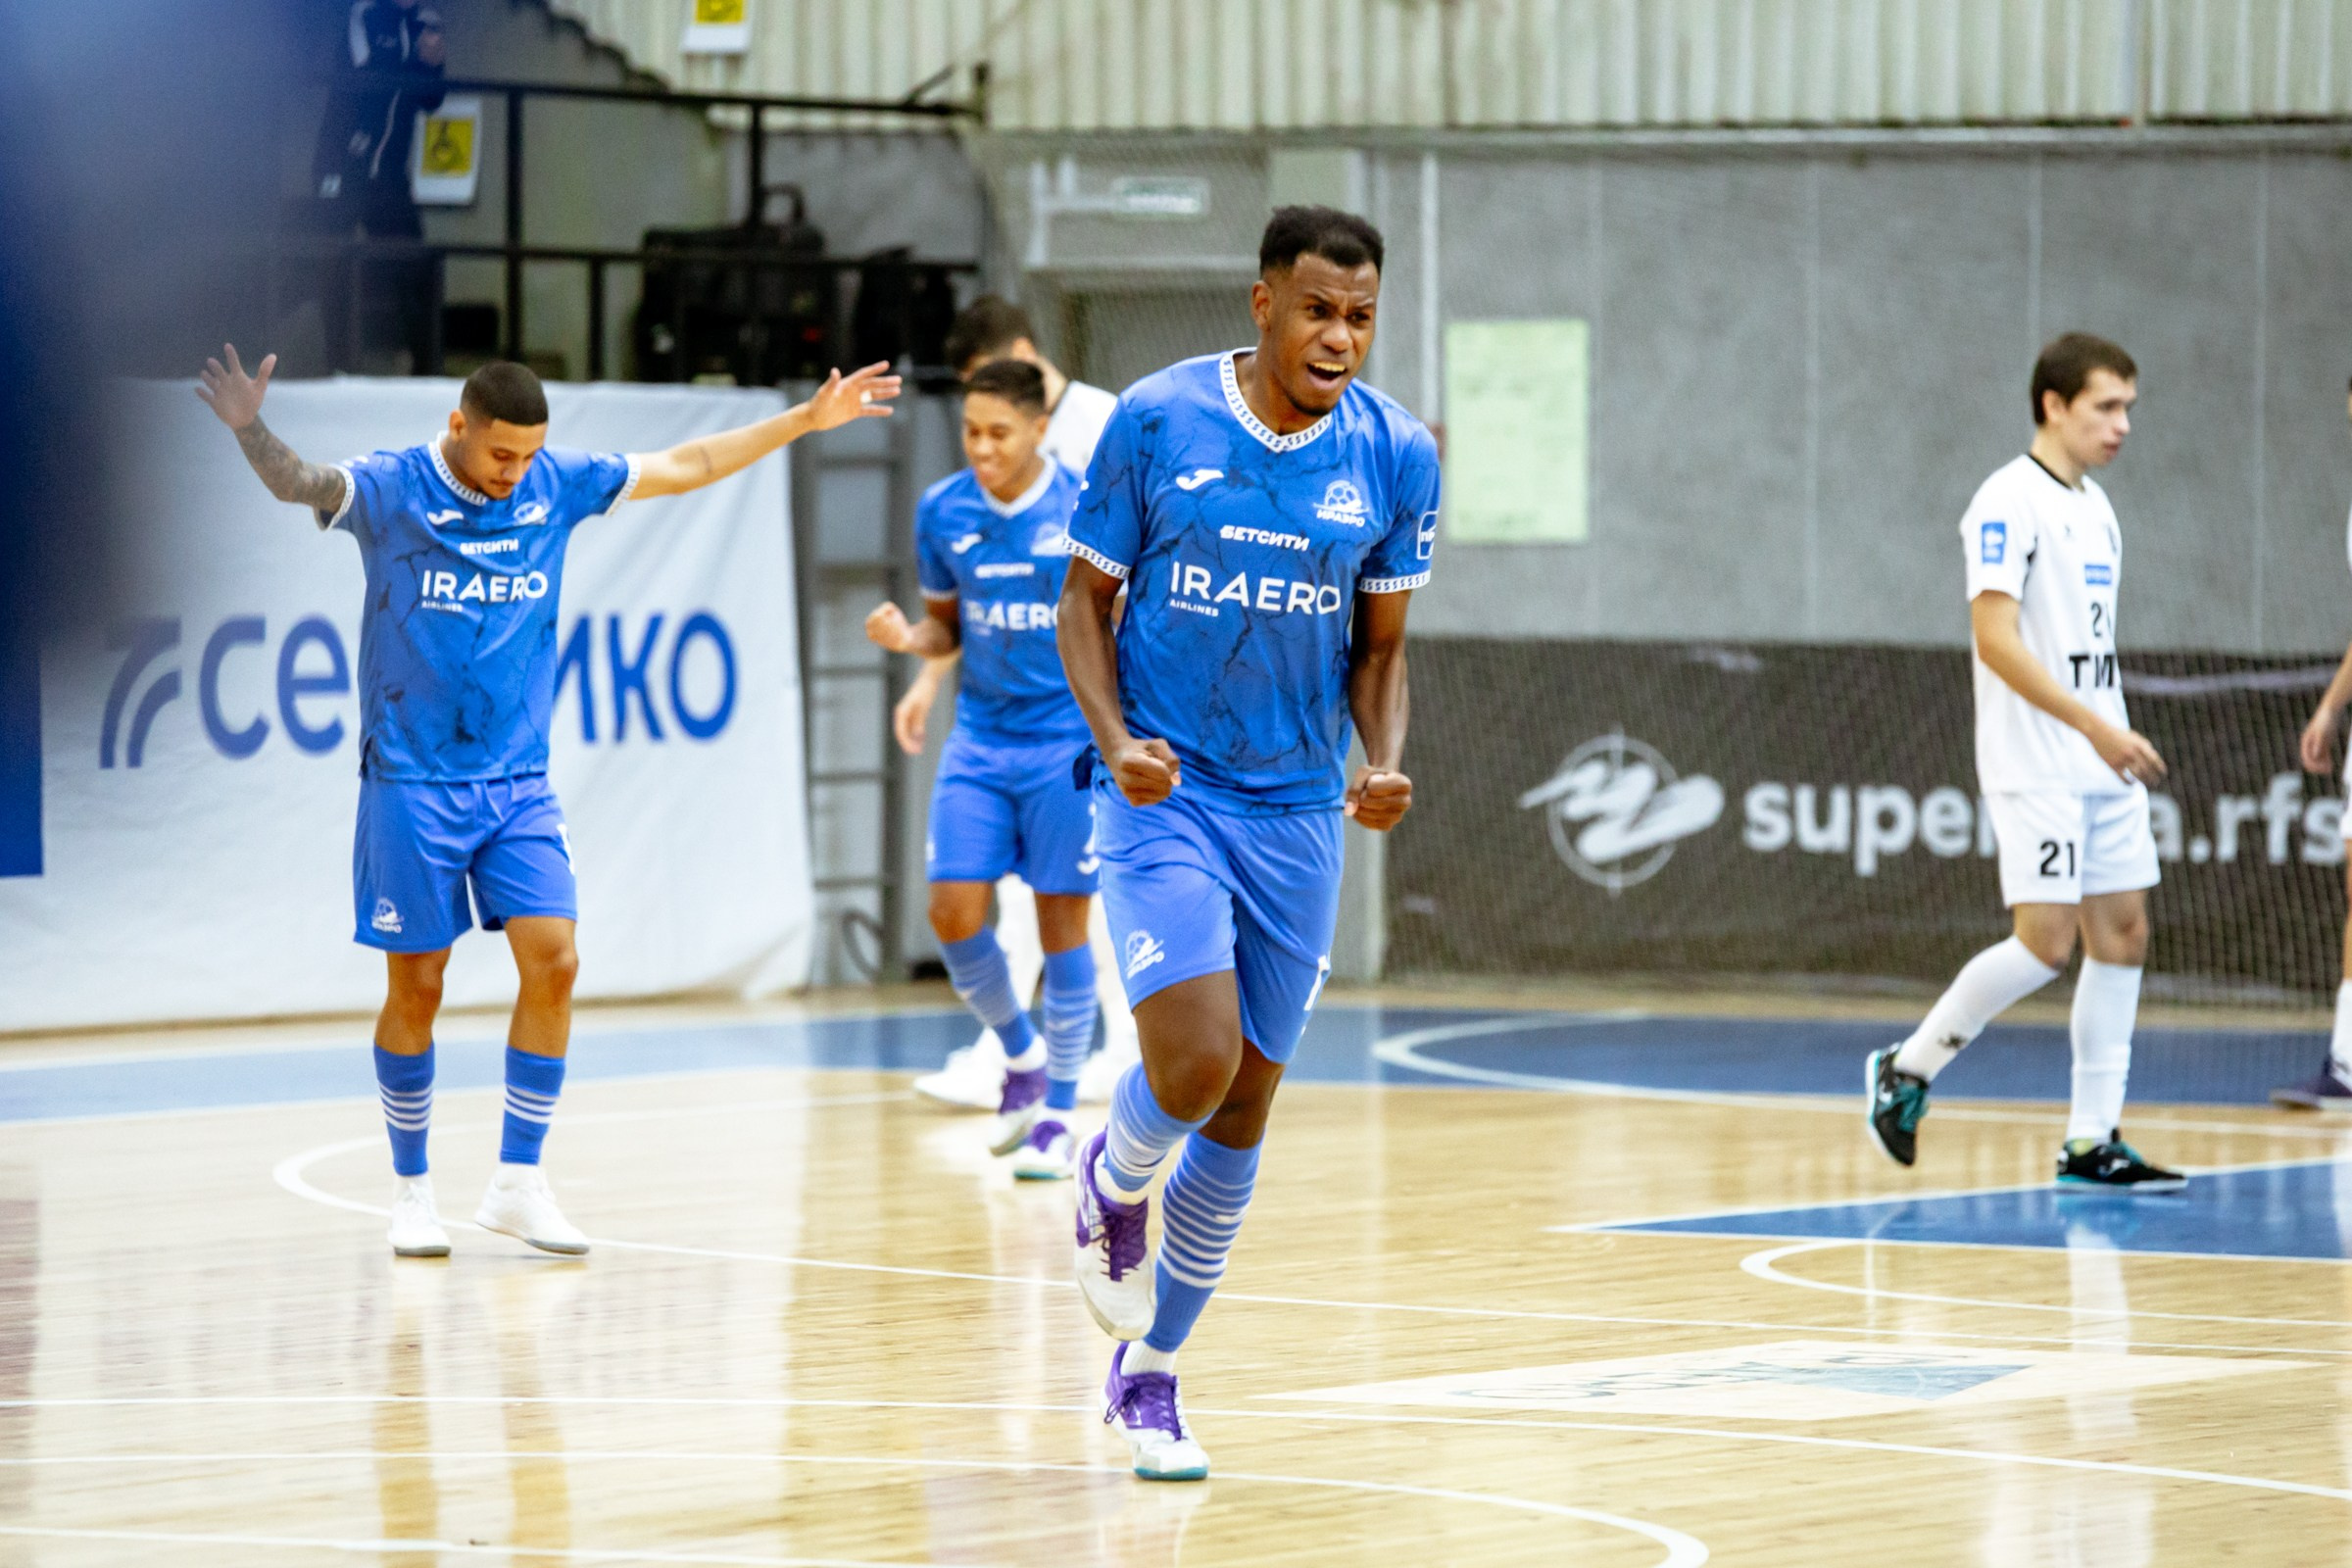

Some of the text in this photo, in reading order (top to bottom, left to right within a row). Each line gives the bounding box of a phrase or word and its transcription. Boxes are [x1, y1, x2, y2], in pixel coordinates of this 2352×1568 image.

[1220, 525, 1310, 552] БЕТСИТИ
[421, 569, 549, 603] IRAERO
[1170, 562, 1342, 615] IRAERO
[1170, 600, 1219, 617] AIRLINES
[2039, 840, 2075, 878] 21
